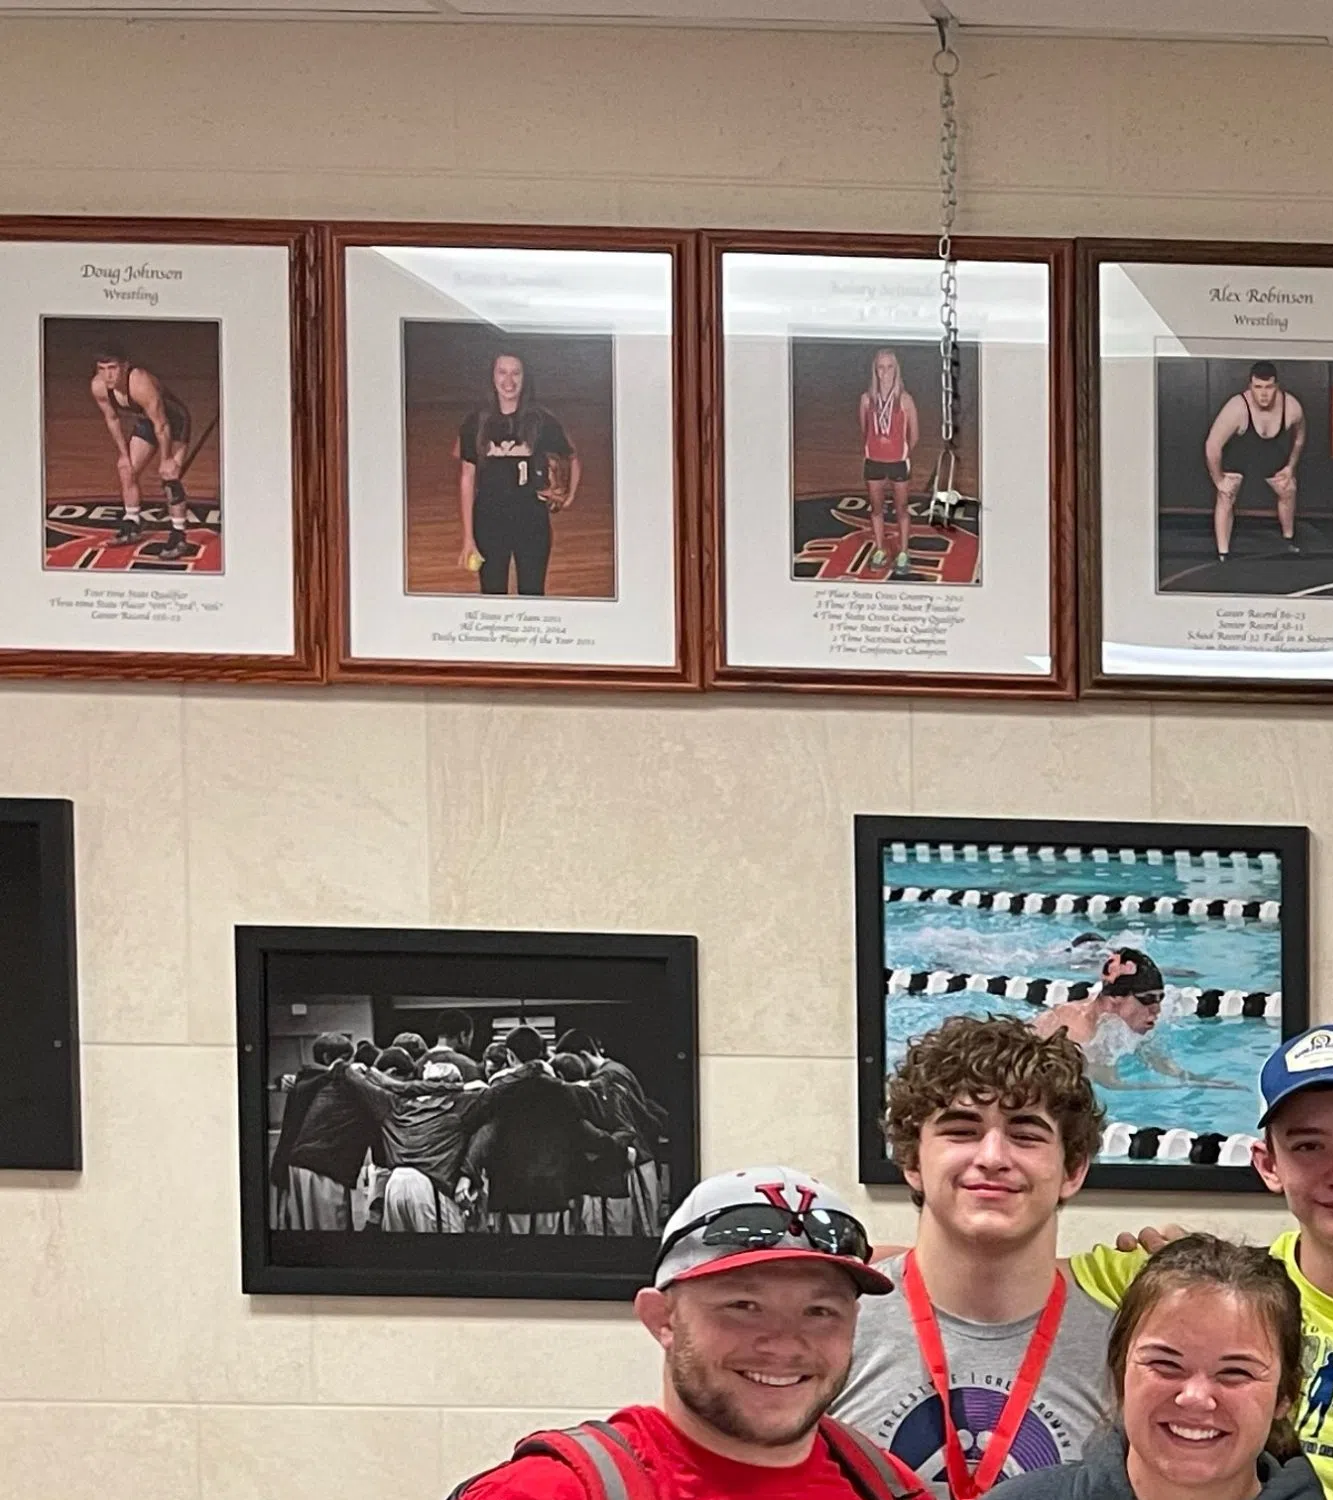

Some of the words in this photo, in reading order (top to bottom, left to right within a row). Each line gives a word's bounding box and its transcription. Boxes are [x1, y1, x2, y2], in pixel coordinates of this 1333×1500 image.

[81, 264, 120, 283] Doug
[123, 264, 183, 284] Johnson
[103, 287, 159, 305] Wrestling
[1209, 287, 1243, 304] Alex
[1247, 288, 1314, 305] Robinson
[1233, 314, 1289, 332] Wrestling
[755, 1182, 818, 1237] V
[879, 1374, 956, 1438] FREESTYE
